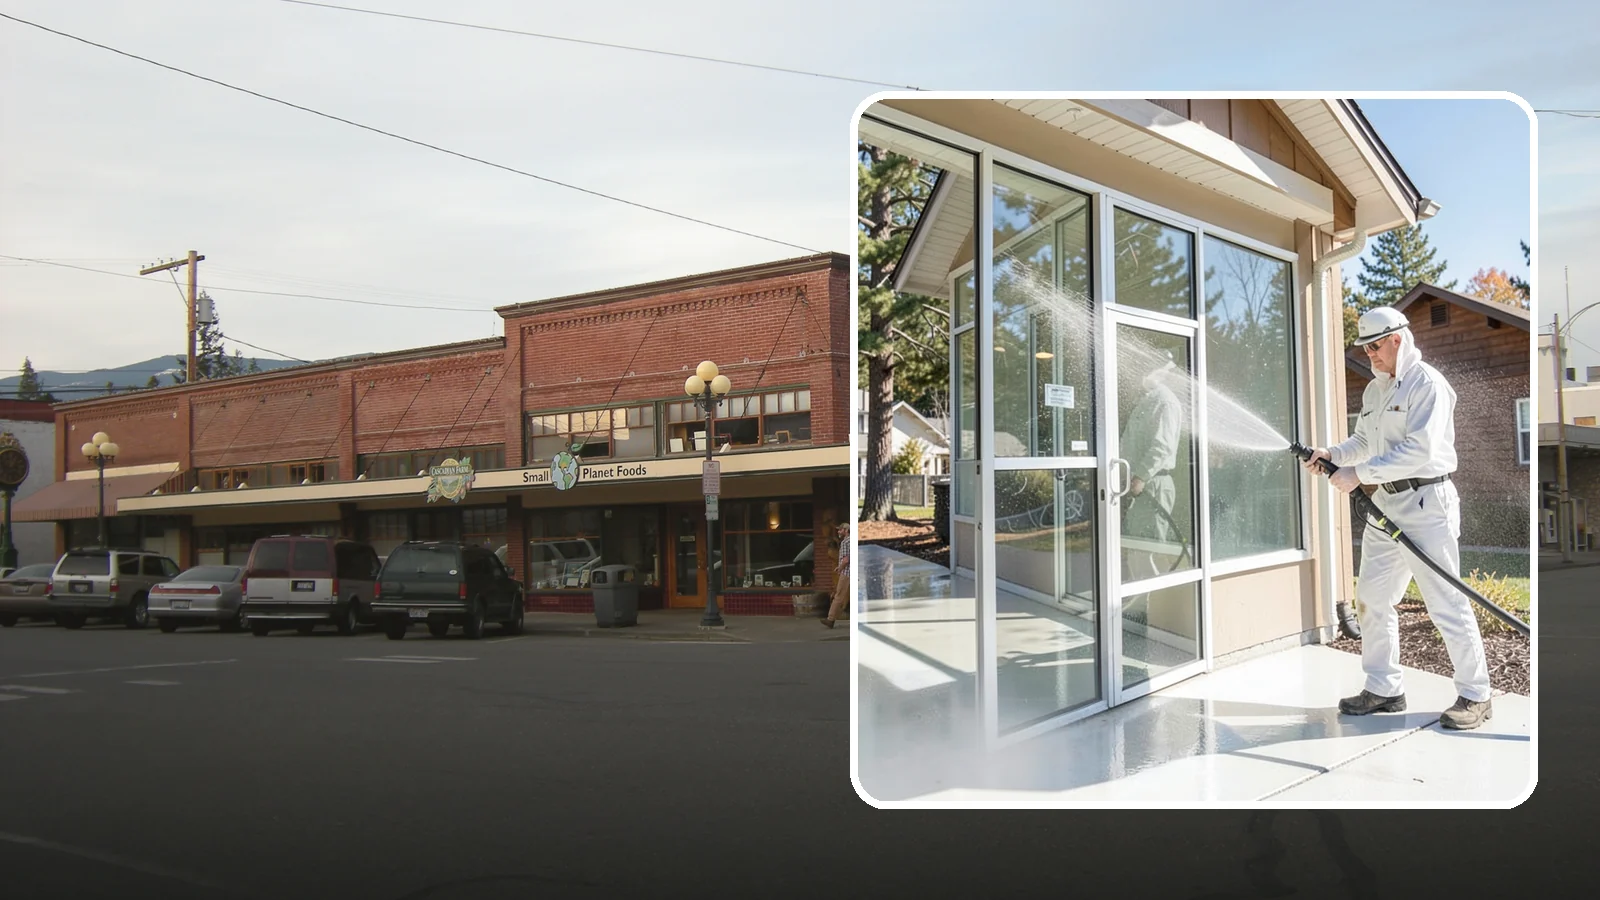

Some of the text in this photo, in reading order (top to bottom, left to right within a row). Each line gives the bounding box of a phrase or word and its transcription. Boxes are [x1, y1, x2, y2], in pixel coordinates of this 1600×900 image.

[523, 464, 647, 482] Small Planet Foods
